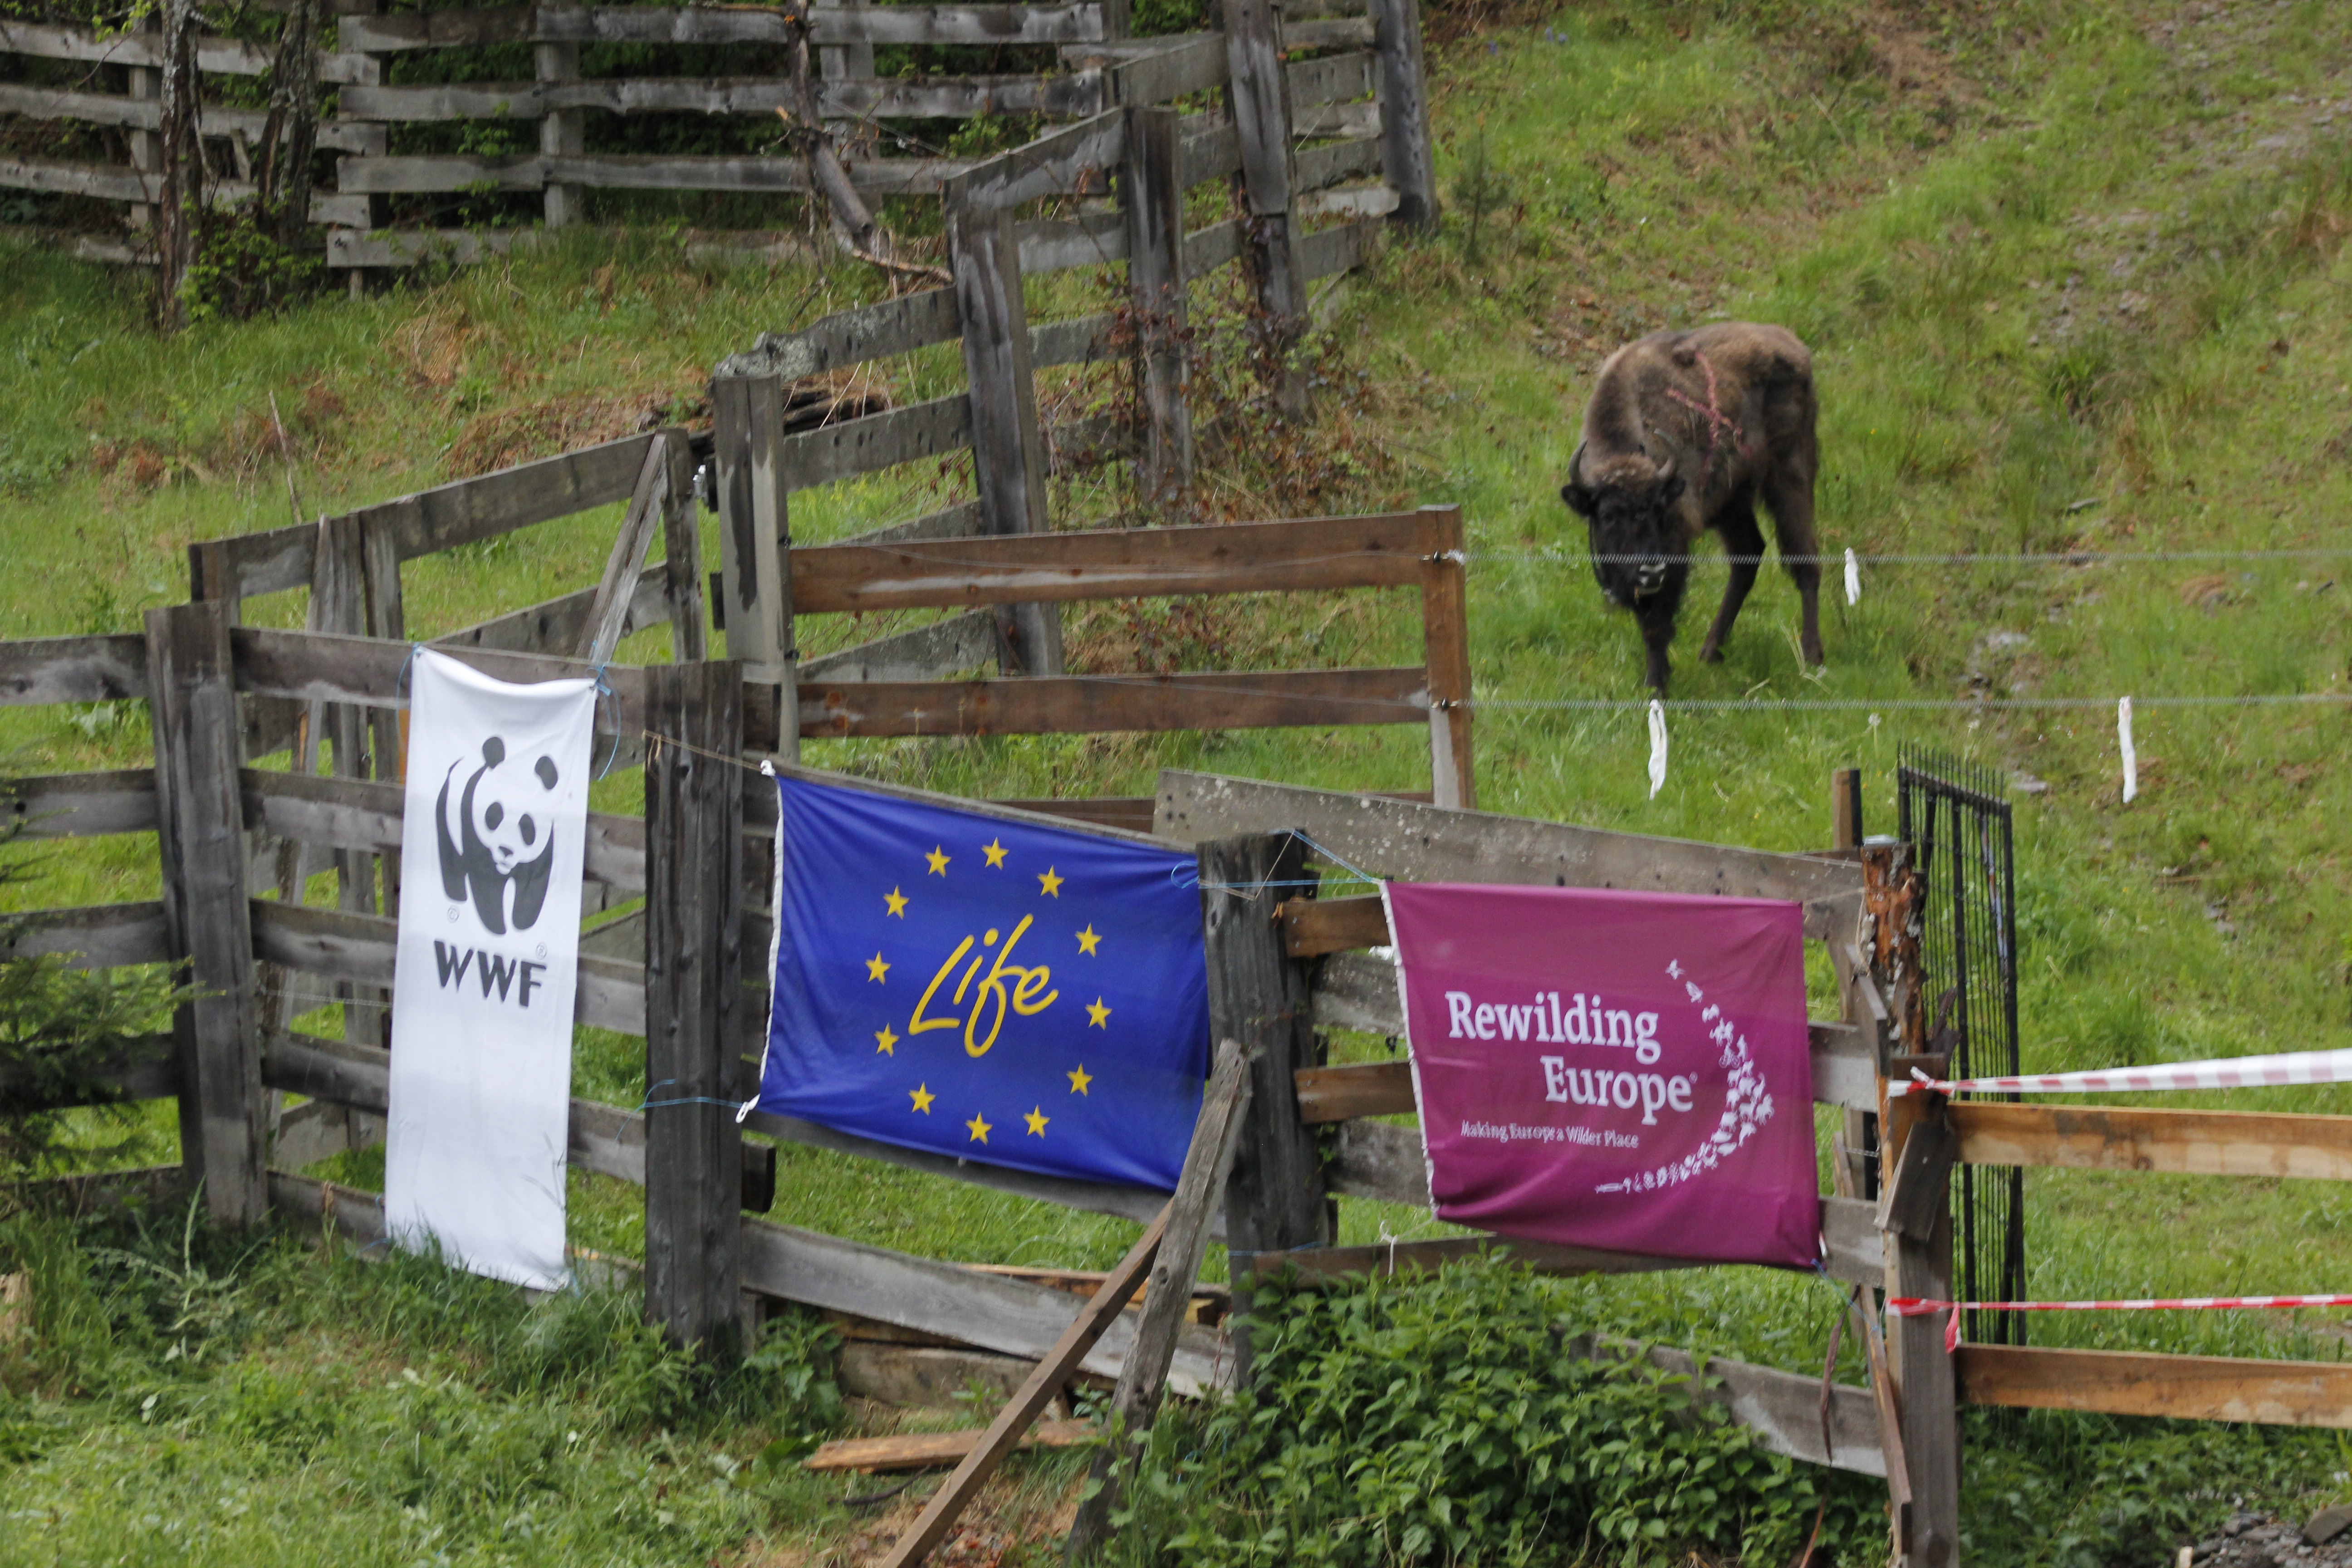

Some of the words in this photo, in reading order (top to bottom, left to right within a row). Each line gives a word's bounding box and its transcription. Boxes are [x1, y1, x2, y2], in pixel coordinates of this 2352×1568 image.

[434, 939, 547, 1008] WWF
[908, 913, 1059, 1058] Life
[1445, 990, 1661, 1065] Rewilding
[1539, 1055, 1694, 1126] Europe
[1460, 1119, 1509, 1143] Making
[1509, 1122, 1555, 1143] Europe
[1556, 1127, 1565, 1142] a
[1565, 1125, 1602, 1146] Wilder
[1603, 1129, 1639, 1149] Place
